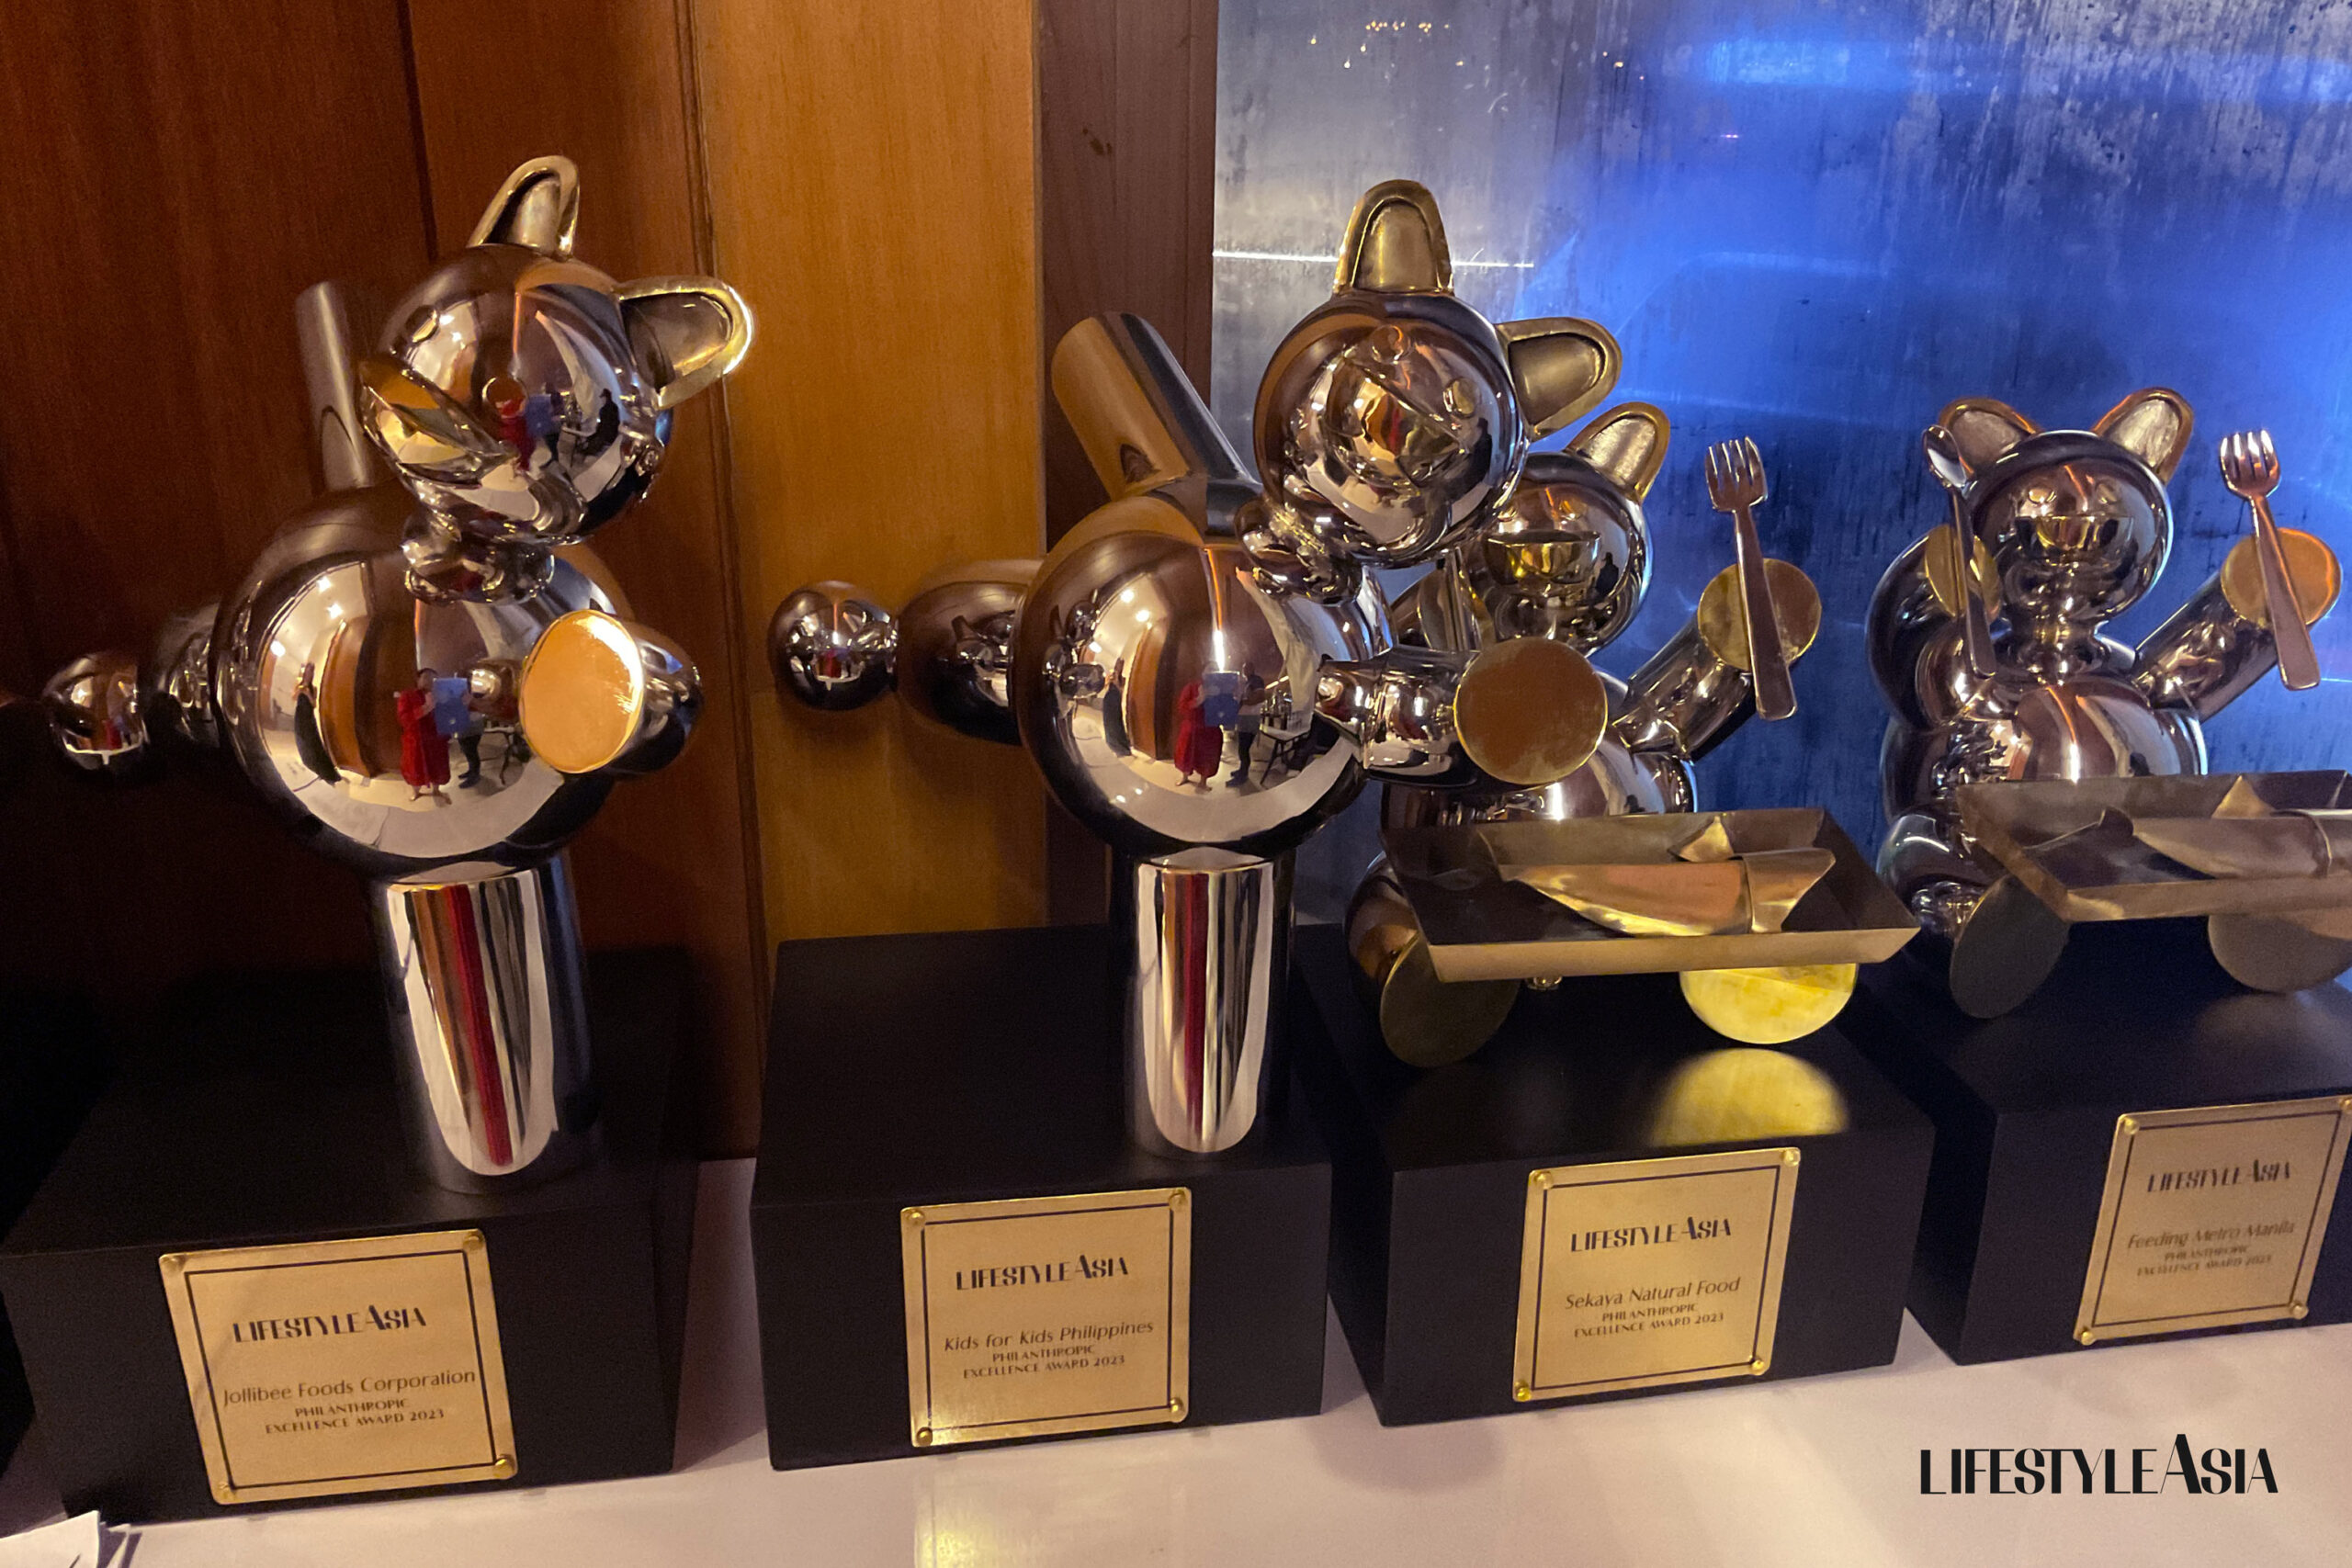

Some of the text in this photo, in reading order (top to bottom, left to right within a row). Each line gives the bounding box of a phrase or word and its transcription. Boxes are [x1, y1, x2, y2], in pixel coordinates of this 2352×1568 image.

[2128, 1221, 2295, 1249] Feeding Metro Manila
[1565, 1277, 1740, 1311] Sekaya Natural Food
[1602, 1303, 1697, 1322] PHILANTHROPIC
[944, 1320, 1154, 1351] Kids for Kids Philippines
[1574, 1313, 1724, 1337] EXCELLENCE AWARD 2023
[992, 1345, 1095, 1362] PHILANTHROPIC
[964, 1355, 1125, 1379] EXCELLENCE AWARD 2023
[224, 1370, 476, 1408] Jollibee Foods Corporation
[295, 1398, 410, 1417] PHILANTHROPIC
[266, 1409, 445, 1434] EXCELLENCE AWARD 2023
